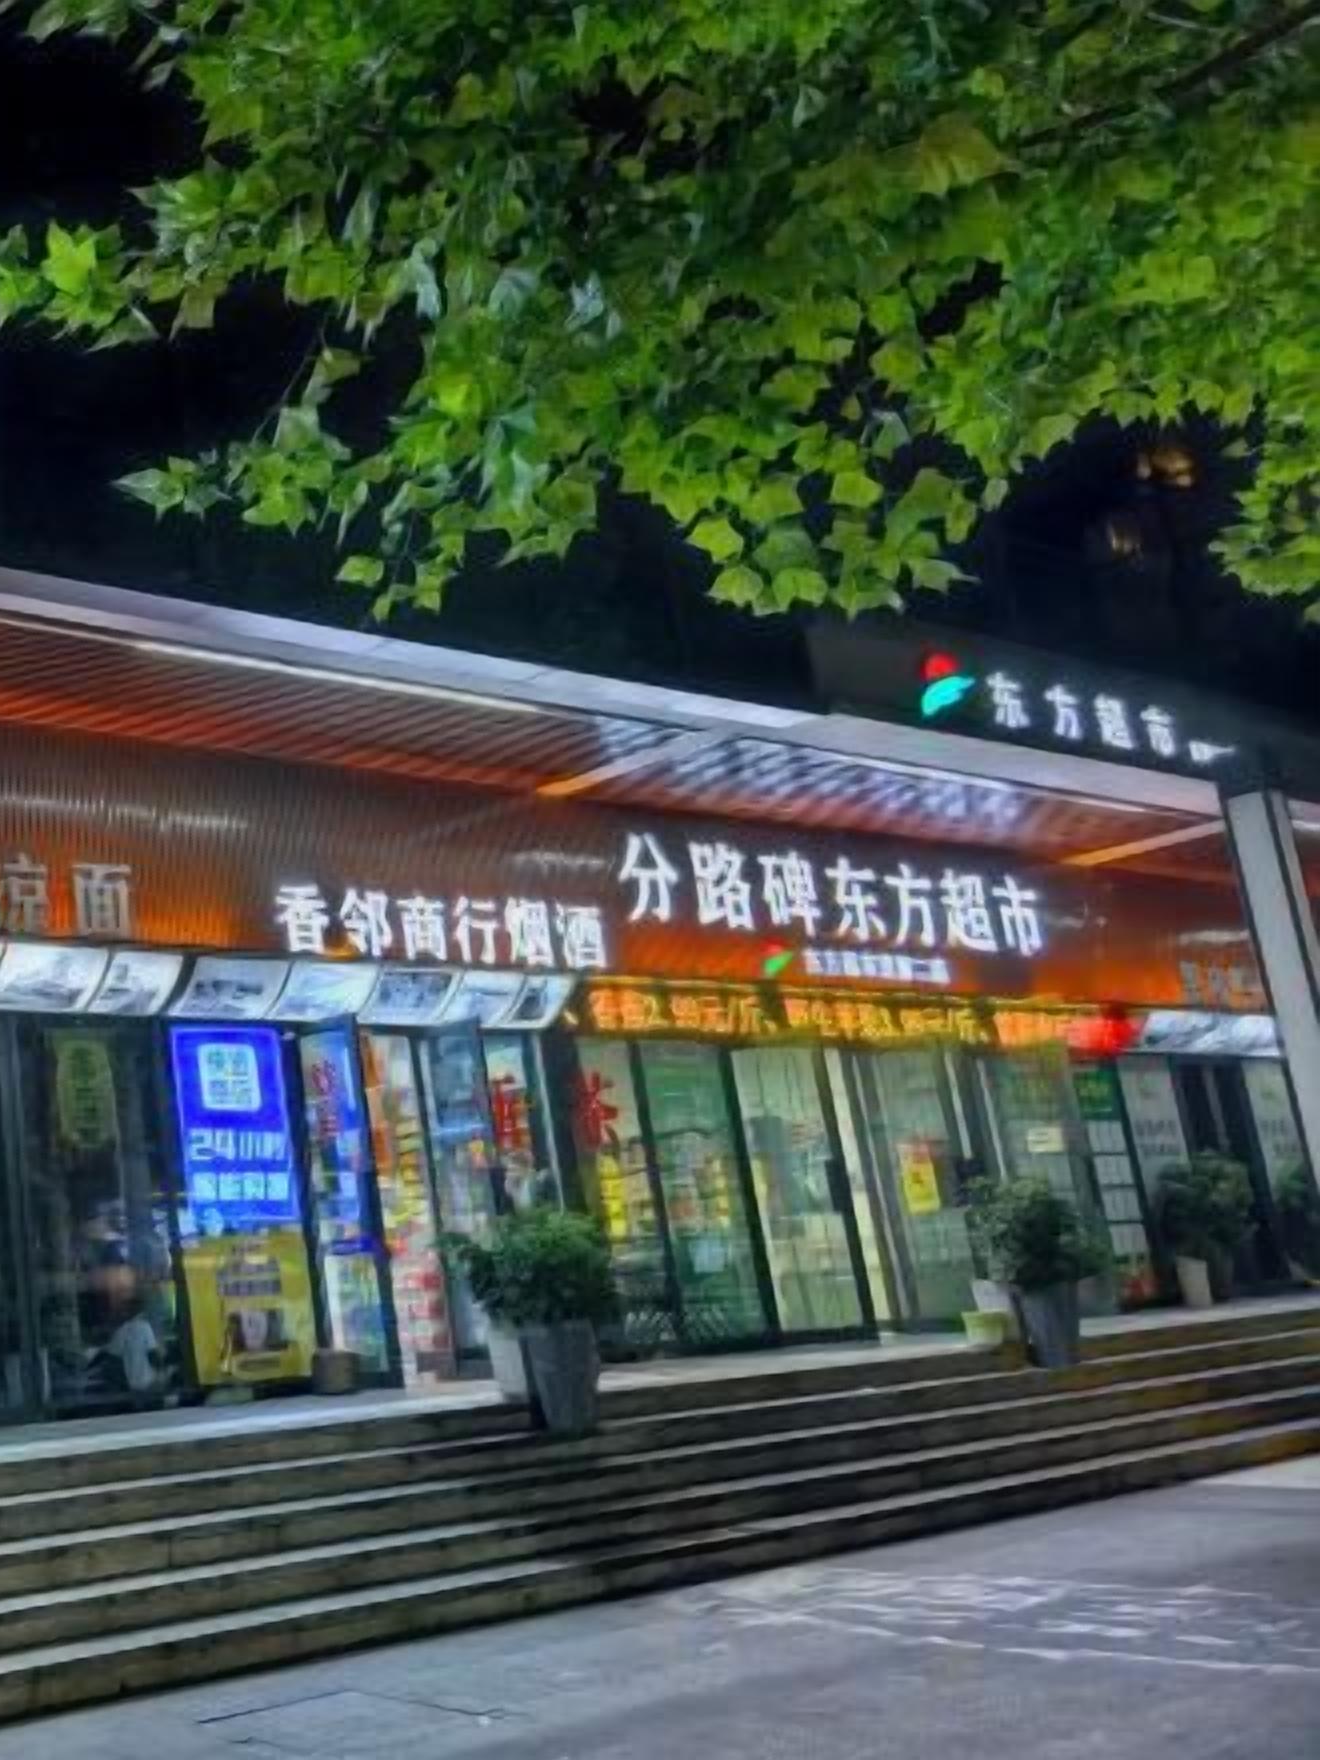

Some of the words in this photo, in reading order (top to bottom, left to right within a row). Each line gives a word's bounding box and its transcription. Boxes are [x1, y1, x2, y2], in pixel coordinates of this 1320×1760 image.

[986, 671, 1177, 757] 东方超市
[273, 883, 607, 968] 香邻商行烟酒
[618, 832, 1046, 956] 分路碑东方超市
